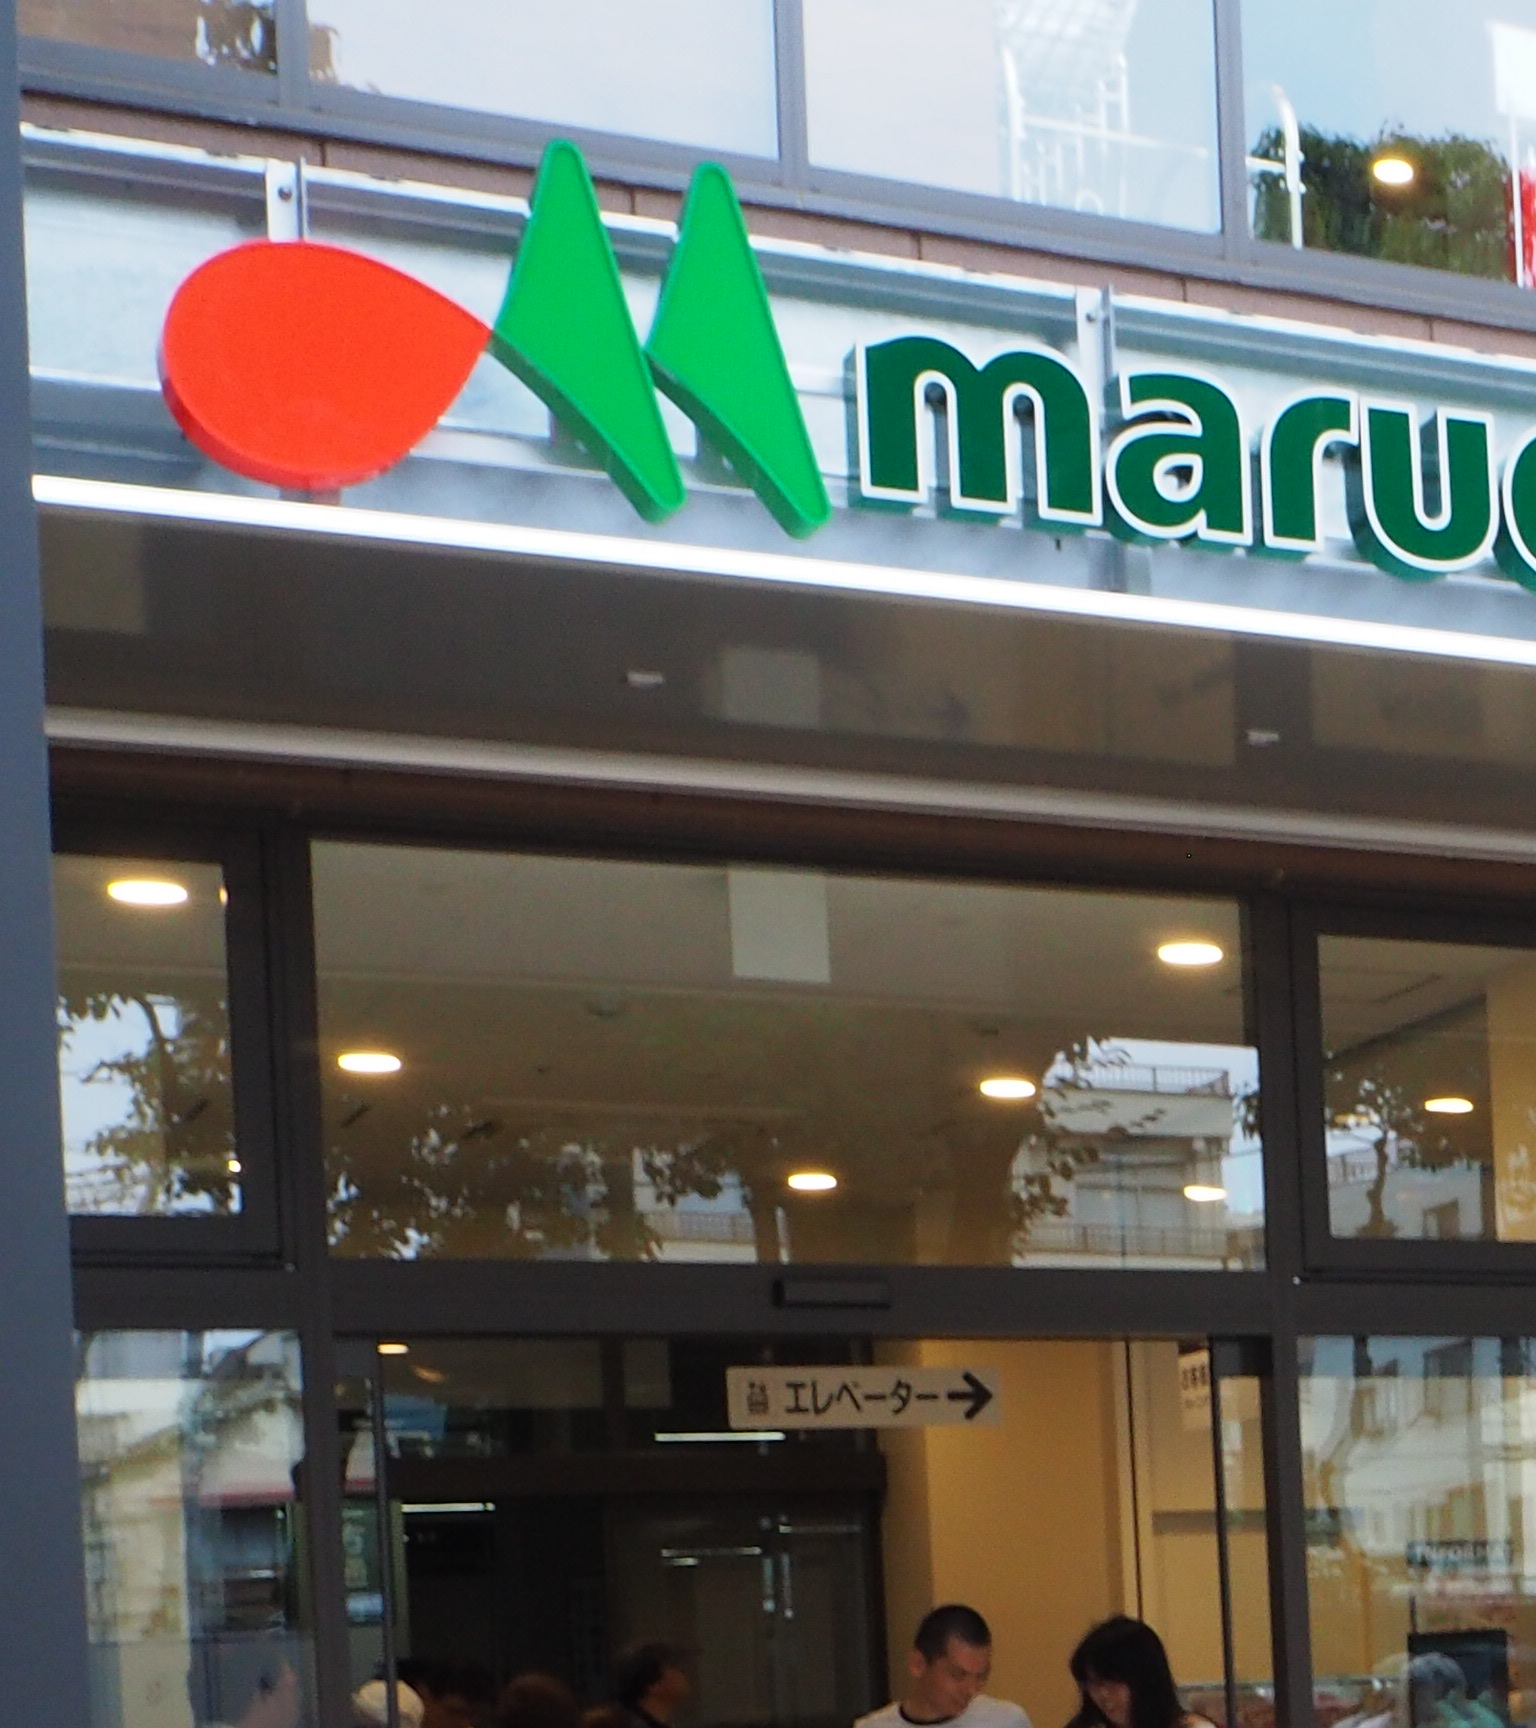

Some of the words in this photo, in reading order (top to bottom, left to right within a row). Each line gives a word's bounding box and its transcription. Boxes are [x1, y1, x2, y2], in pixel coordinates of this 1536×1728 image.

[785, 1378, 939, 1415] エレベーター
